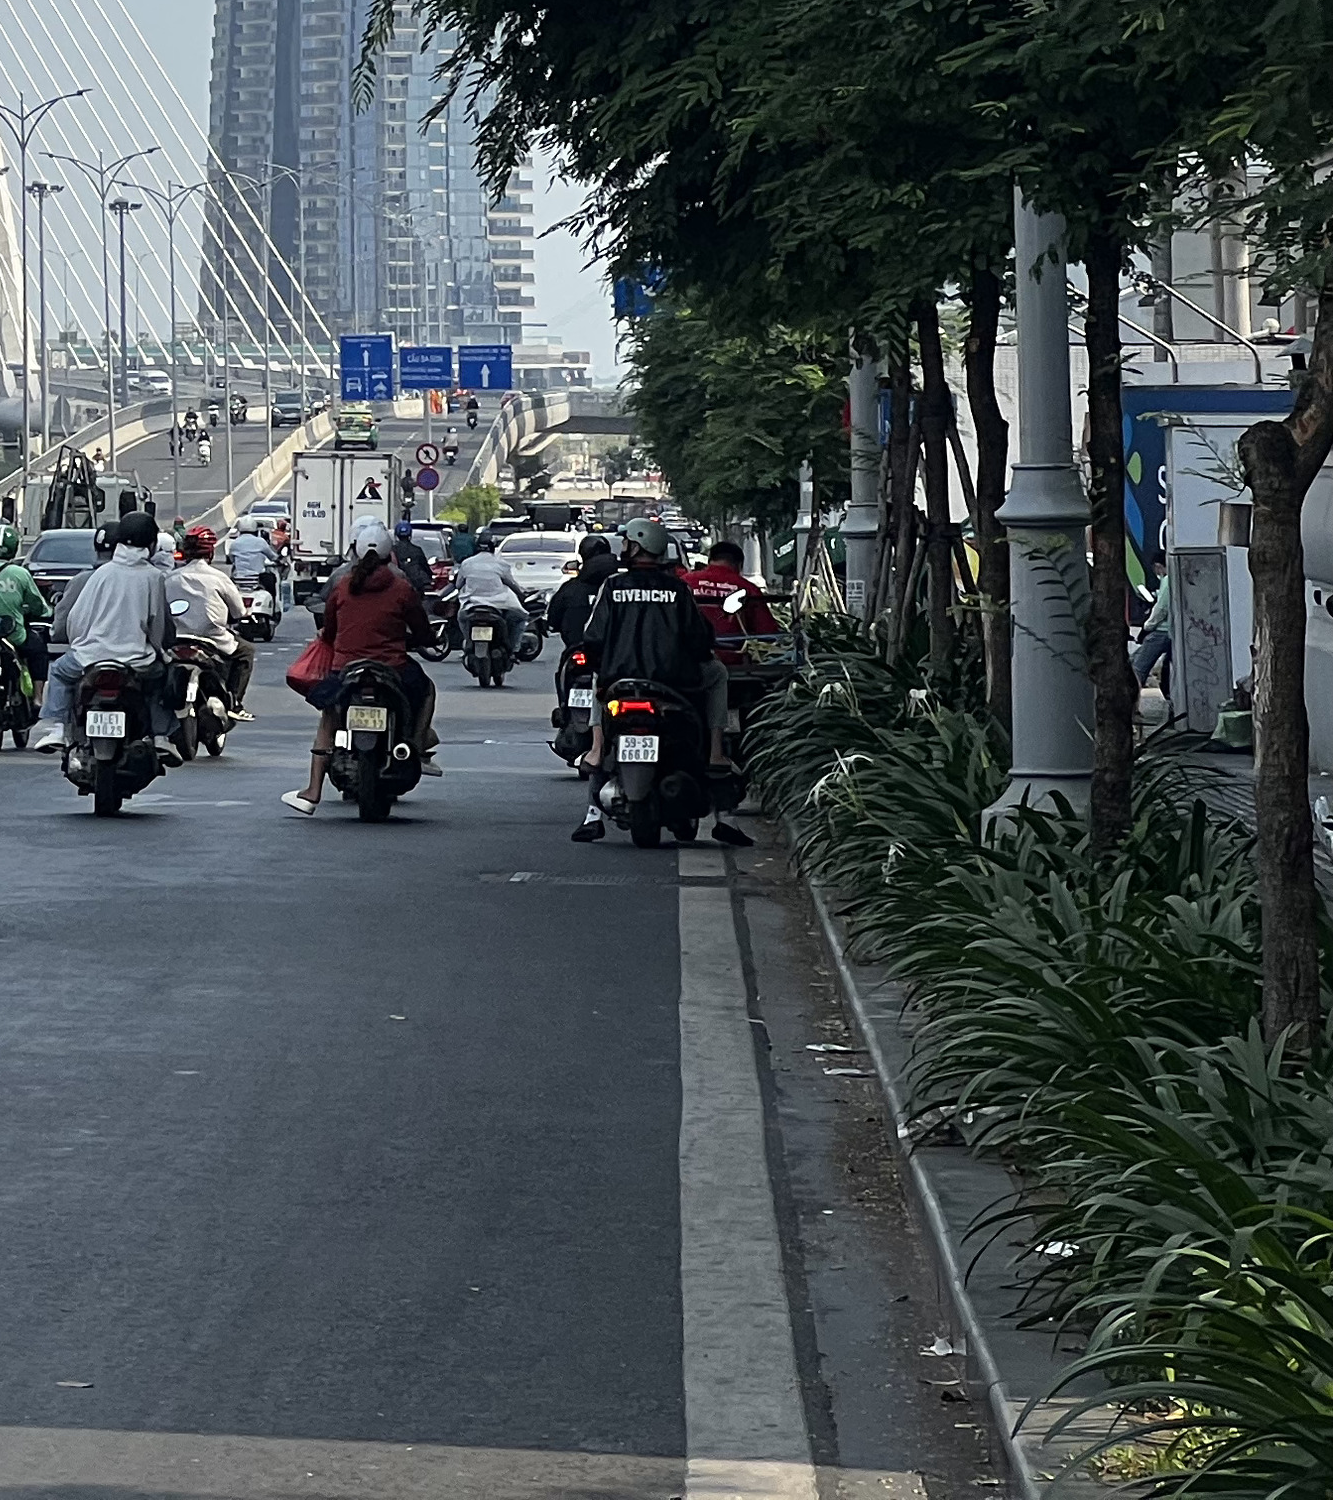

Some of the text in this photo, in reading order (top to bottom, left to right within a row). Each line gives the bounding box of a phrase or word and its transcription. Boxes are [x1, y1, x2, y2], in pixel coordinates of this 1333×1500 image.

[612, 589, 677, 603] GIVENCHY
[624, 737, 654, 748] 59-S3
[621, 749, 656, 761] 666.02
